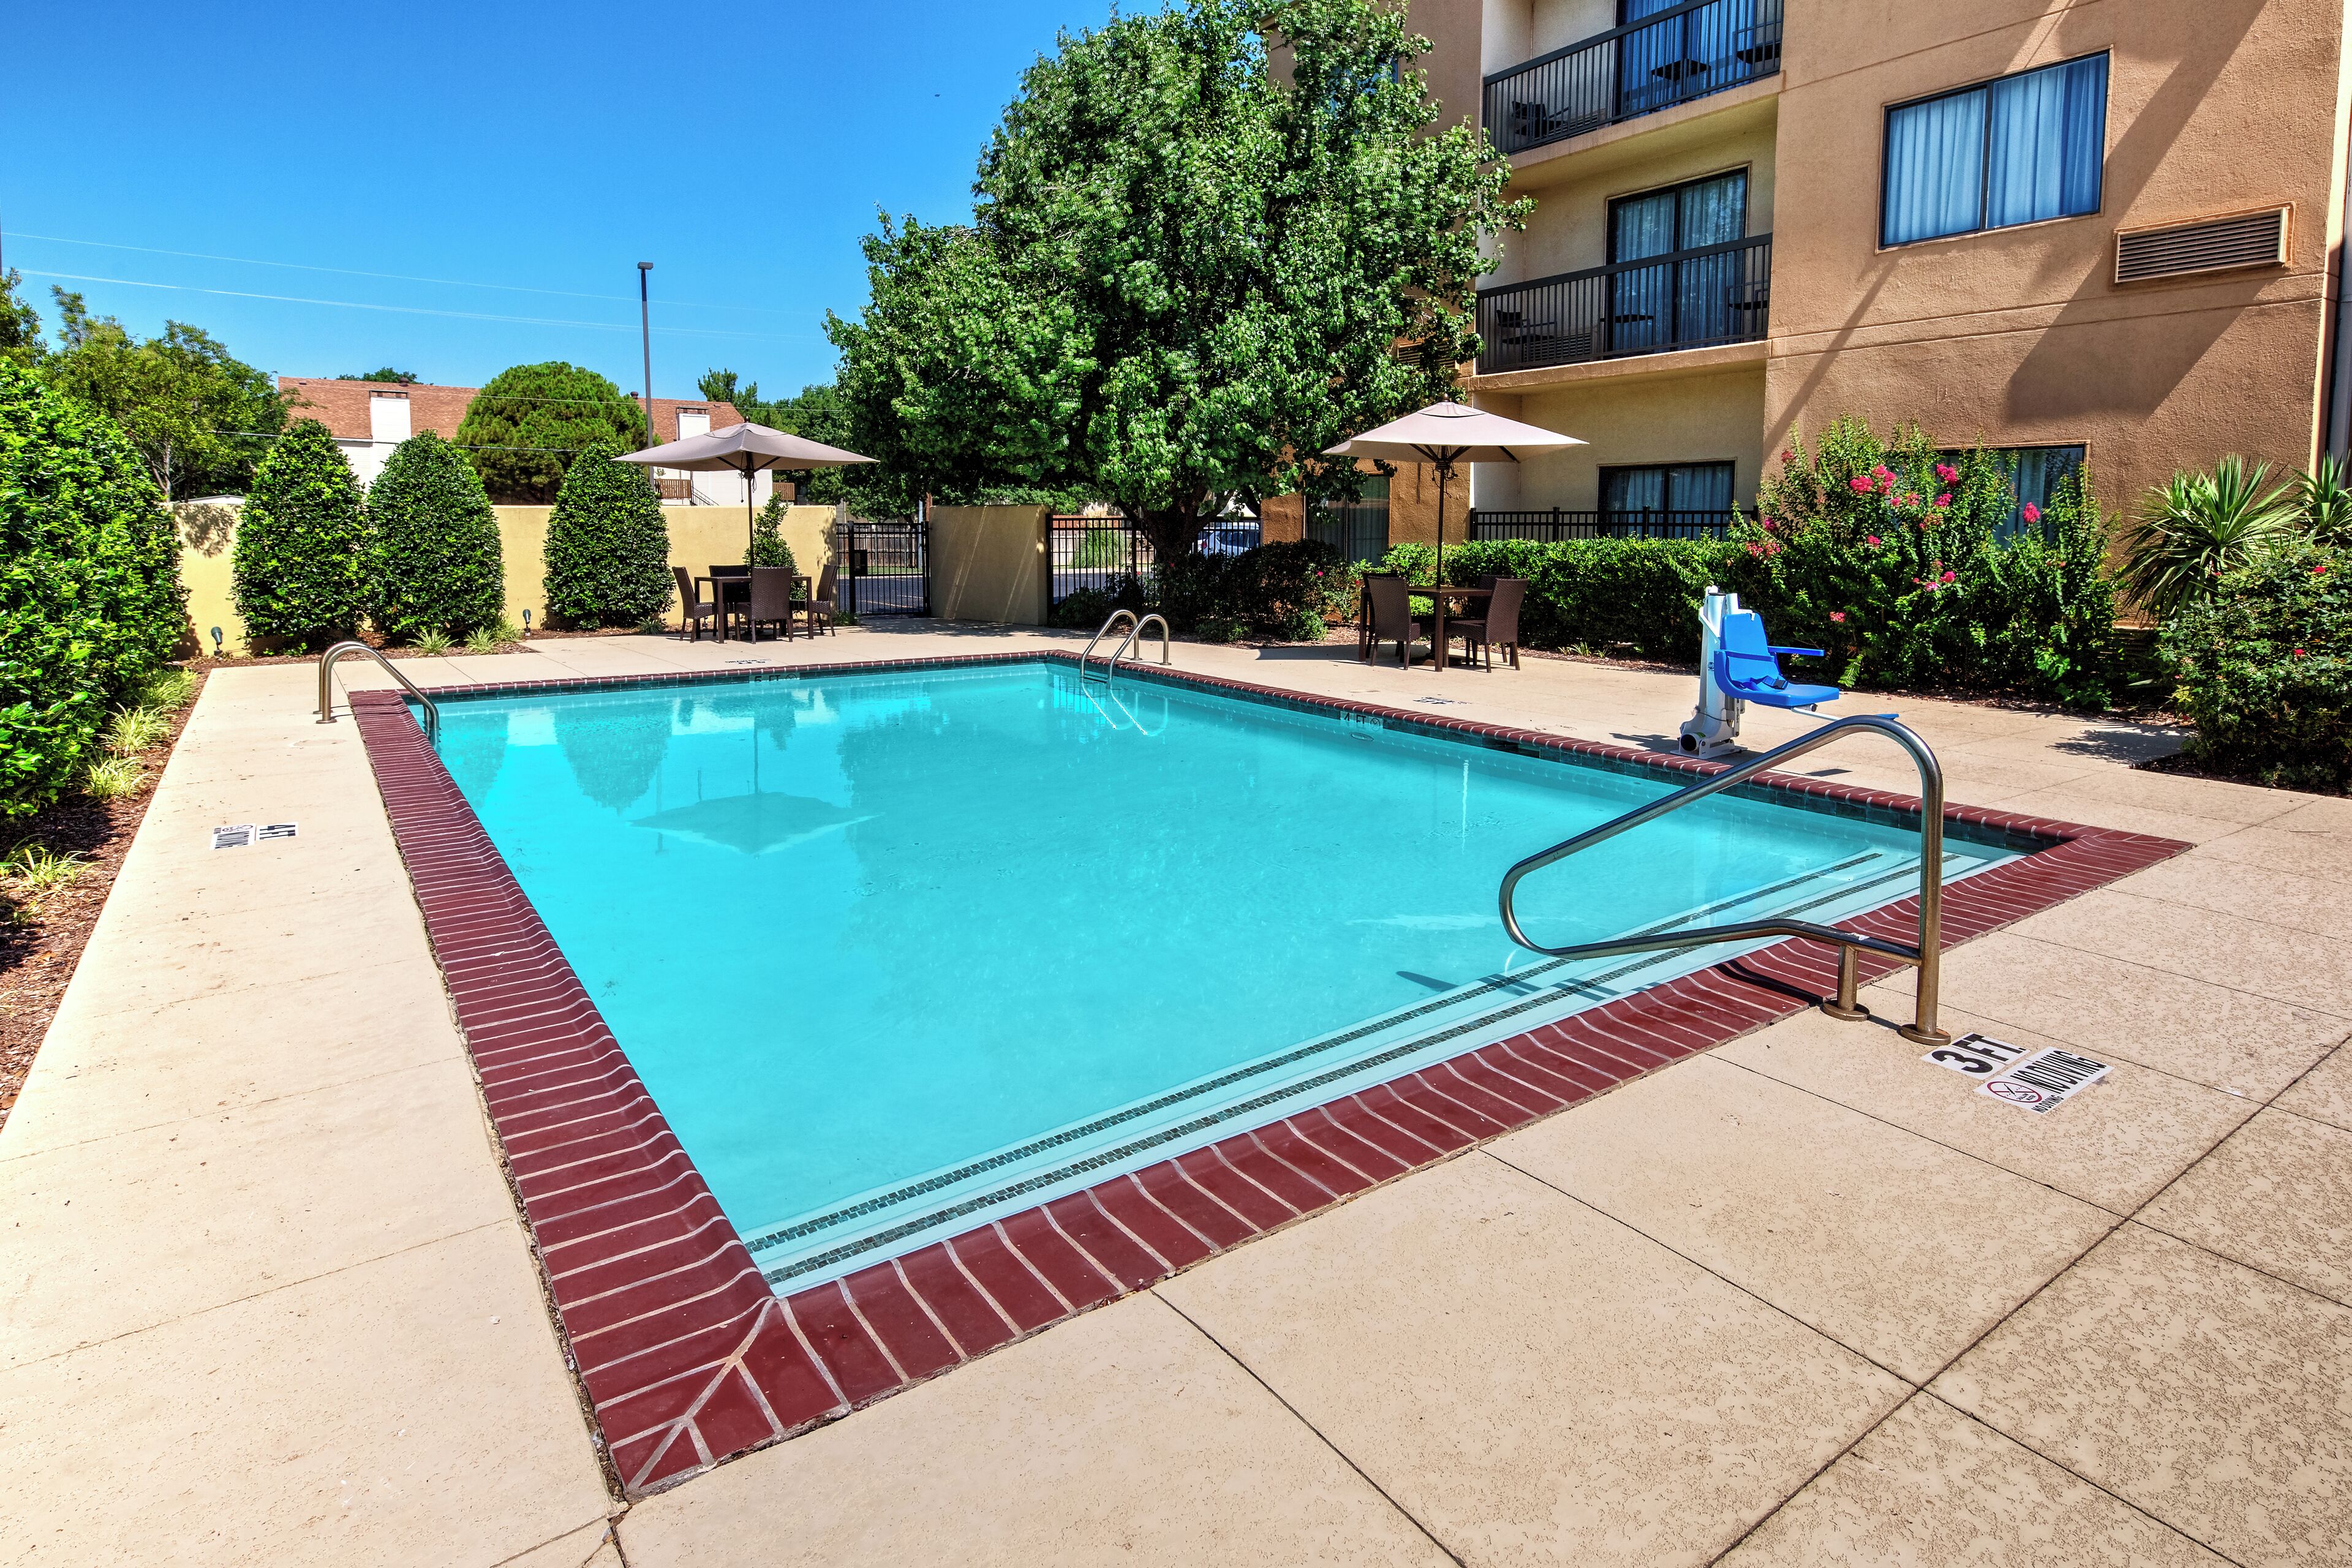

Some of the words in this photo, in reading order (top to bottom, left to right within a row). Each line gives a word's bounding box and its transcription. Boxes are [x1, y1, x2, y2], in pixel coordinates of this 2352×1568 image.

[1356, 714, 1366, 724] FT
[1932, 1050, 1994, 1073] 3
[2025, 1050, 2107, 1085] DIVING
[2010, 1070, 2071, 1094] NO
[2031, 1105, 2049, 1114] NO
[2038, 1095, 2064, 1108] DIVING
